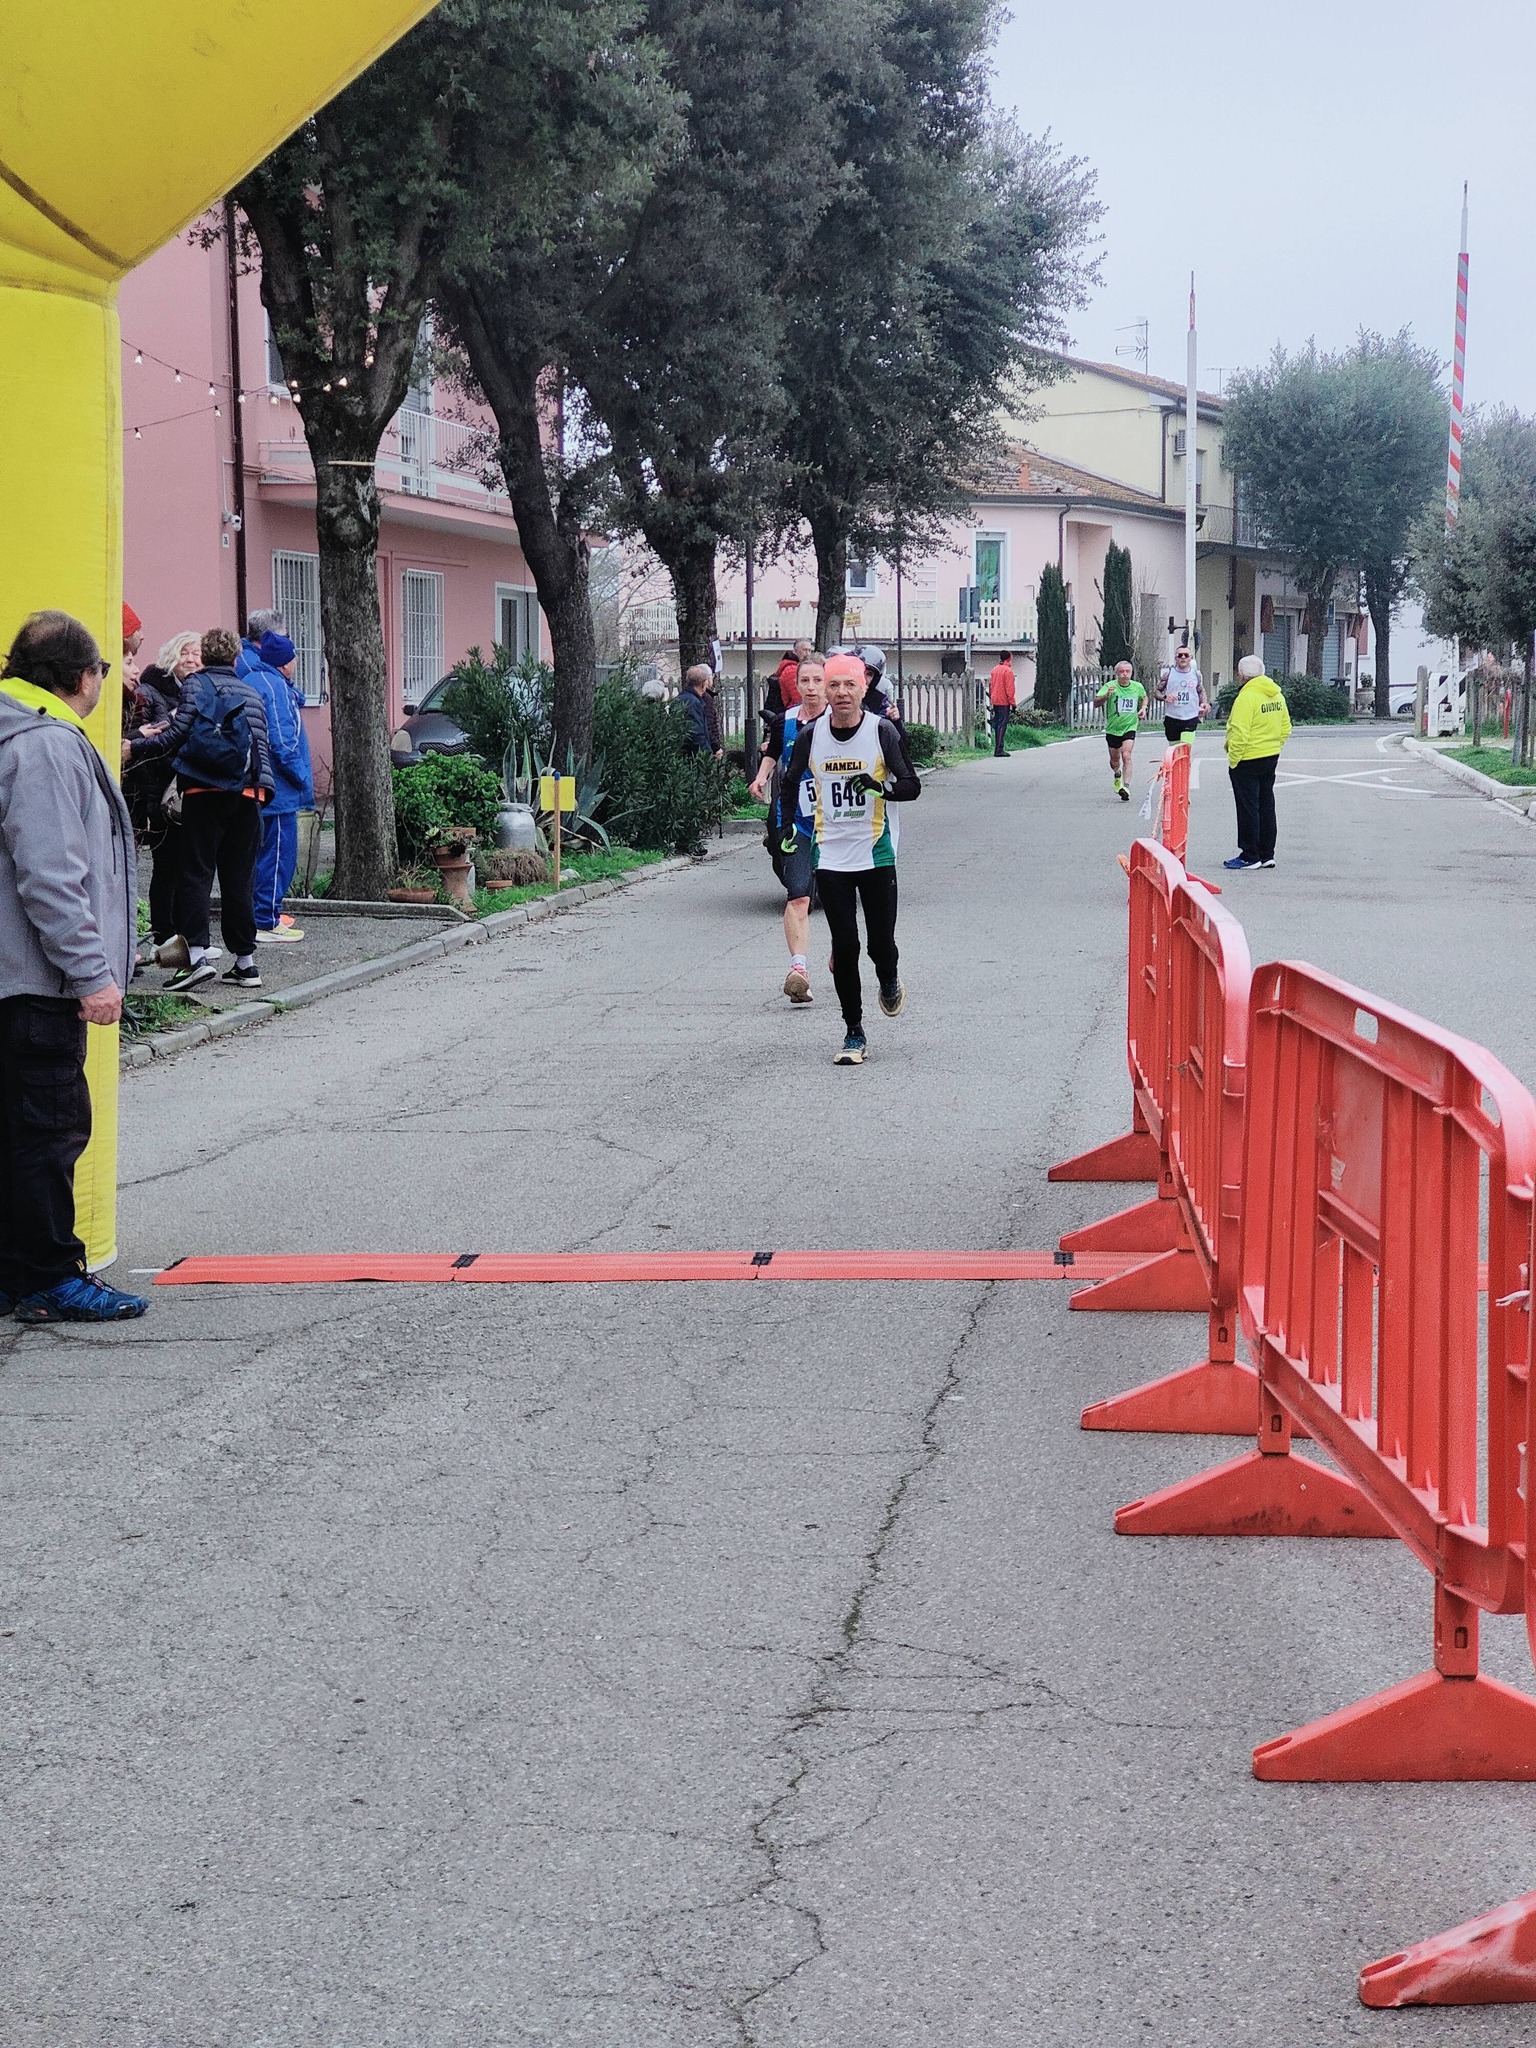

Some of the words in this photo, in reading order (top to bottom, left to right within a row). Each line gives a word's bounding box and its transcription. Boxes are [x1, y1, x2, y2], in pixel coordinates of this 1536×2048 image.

[1177, 691, 1190, 702] 520
[1121, 698, 1134, 708] 739
[825, 761, 862, 772] MAMELI
[805, 780, 817, 802] 5
